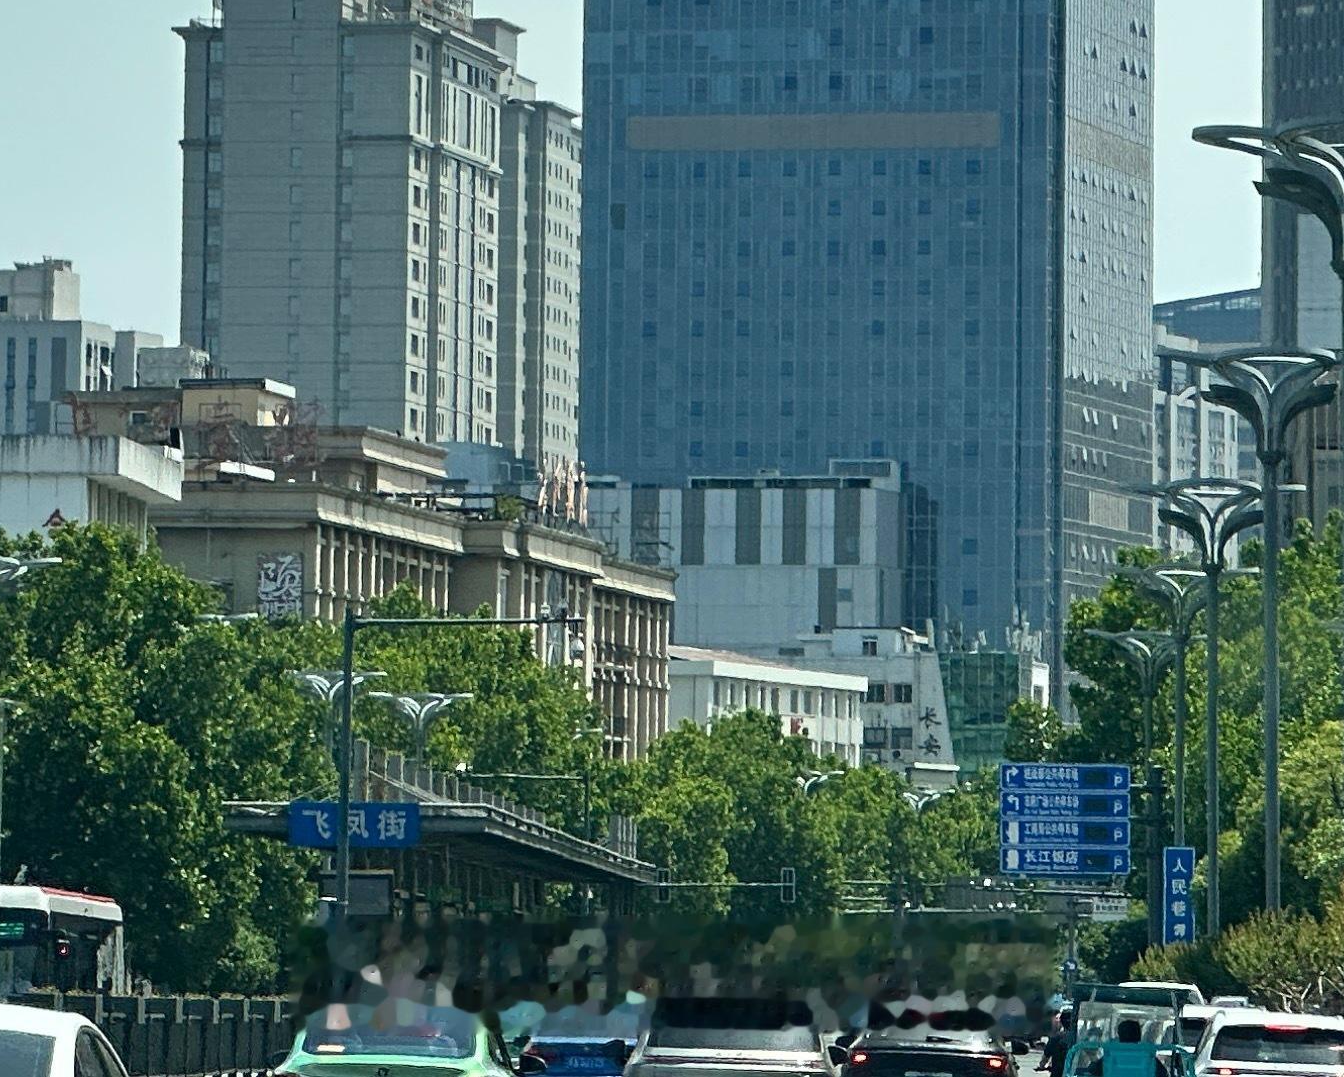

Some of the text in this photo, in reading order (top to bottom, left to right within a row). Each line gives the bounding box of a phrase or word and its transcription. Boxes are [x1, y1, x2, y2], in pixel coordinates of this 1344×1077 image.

[1113, 775, 1124, 787] P
[1113, 802, 1124, 815] P
[302, 809, 407, 840] 飞凤街
[1113, 830, 1124, 842] P
[1113, 858, 1124, 870] P
